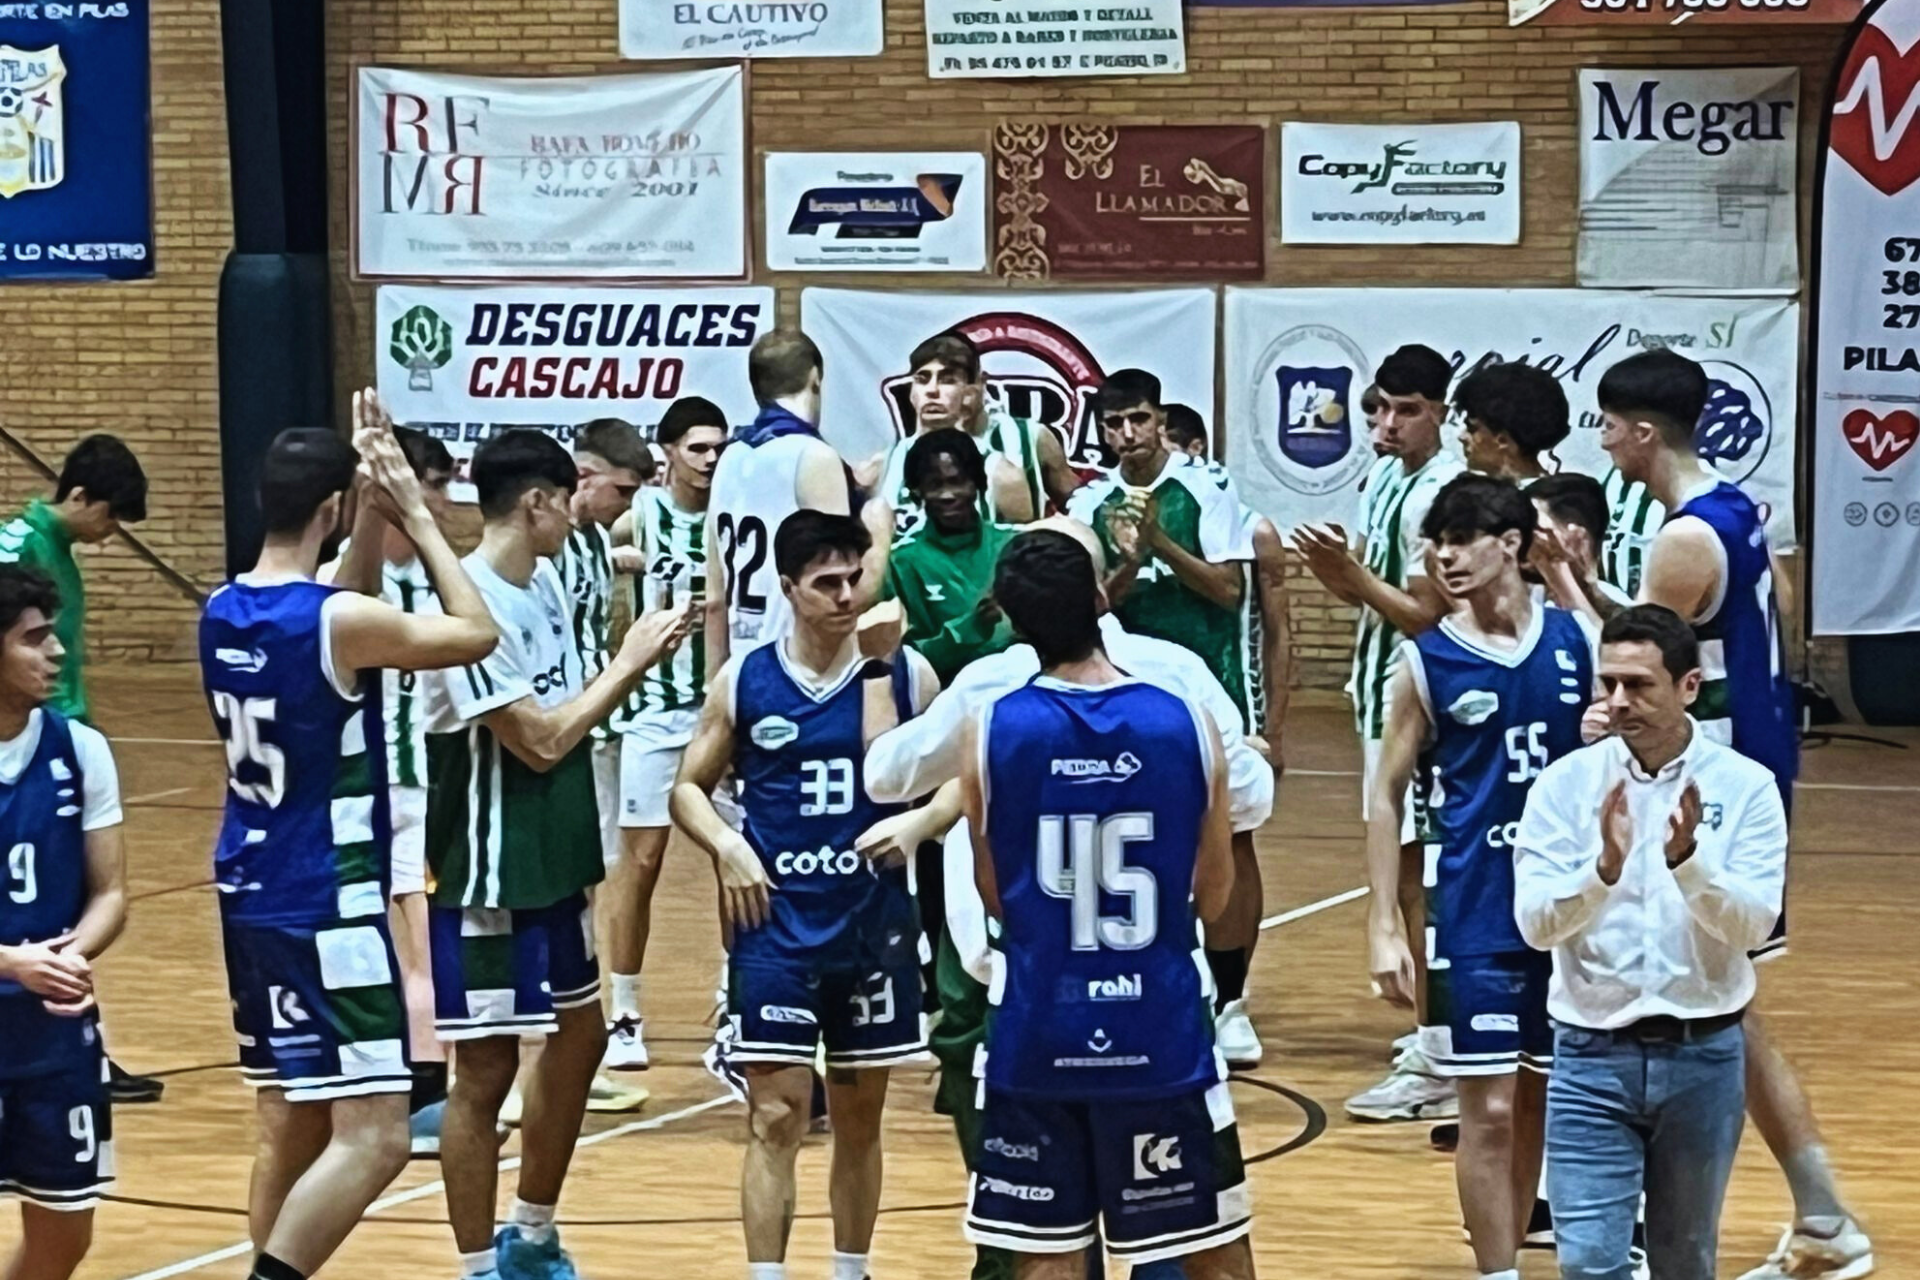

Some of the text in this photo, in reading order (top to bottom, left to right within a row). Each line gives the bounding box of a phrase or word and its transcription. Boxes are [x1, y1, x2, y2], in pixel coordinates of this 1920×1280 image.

[44, 3, 73, 19] EN
[674, 3, 828, 24] EL CAUTIVO
[1592, 80, 1795, 156] Megar
[1096, 191, 1229, 213] LLAMADOR
[14, 243, 41, 260] LO
[48, 243, 146, 260] NUESTRO
[1884, 237, 1920, 262] 67
[1881, 270, 1920, 295] 38
[465, 302, 762, 347] DESGUACES
[1883, 304, 1920, 328] 27
[469, 356, 685, 399] CASCAJO
[1504, 721, 1549, 783] 55
[800, 757, 855, 816] 33
[8, 842, 37, 903] 9
[775, 845, 860, 875] coto
[1036, 811, 1158, 951] 45
[68, 1104, 97, 1162] 9
